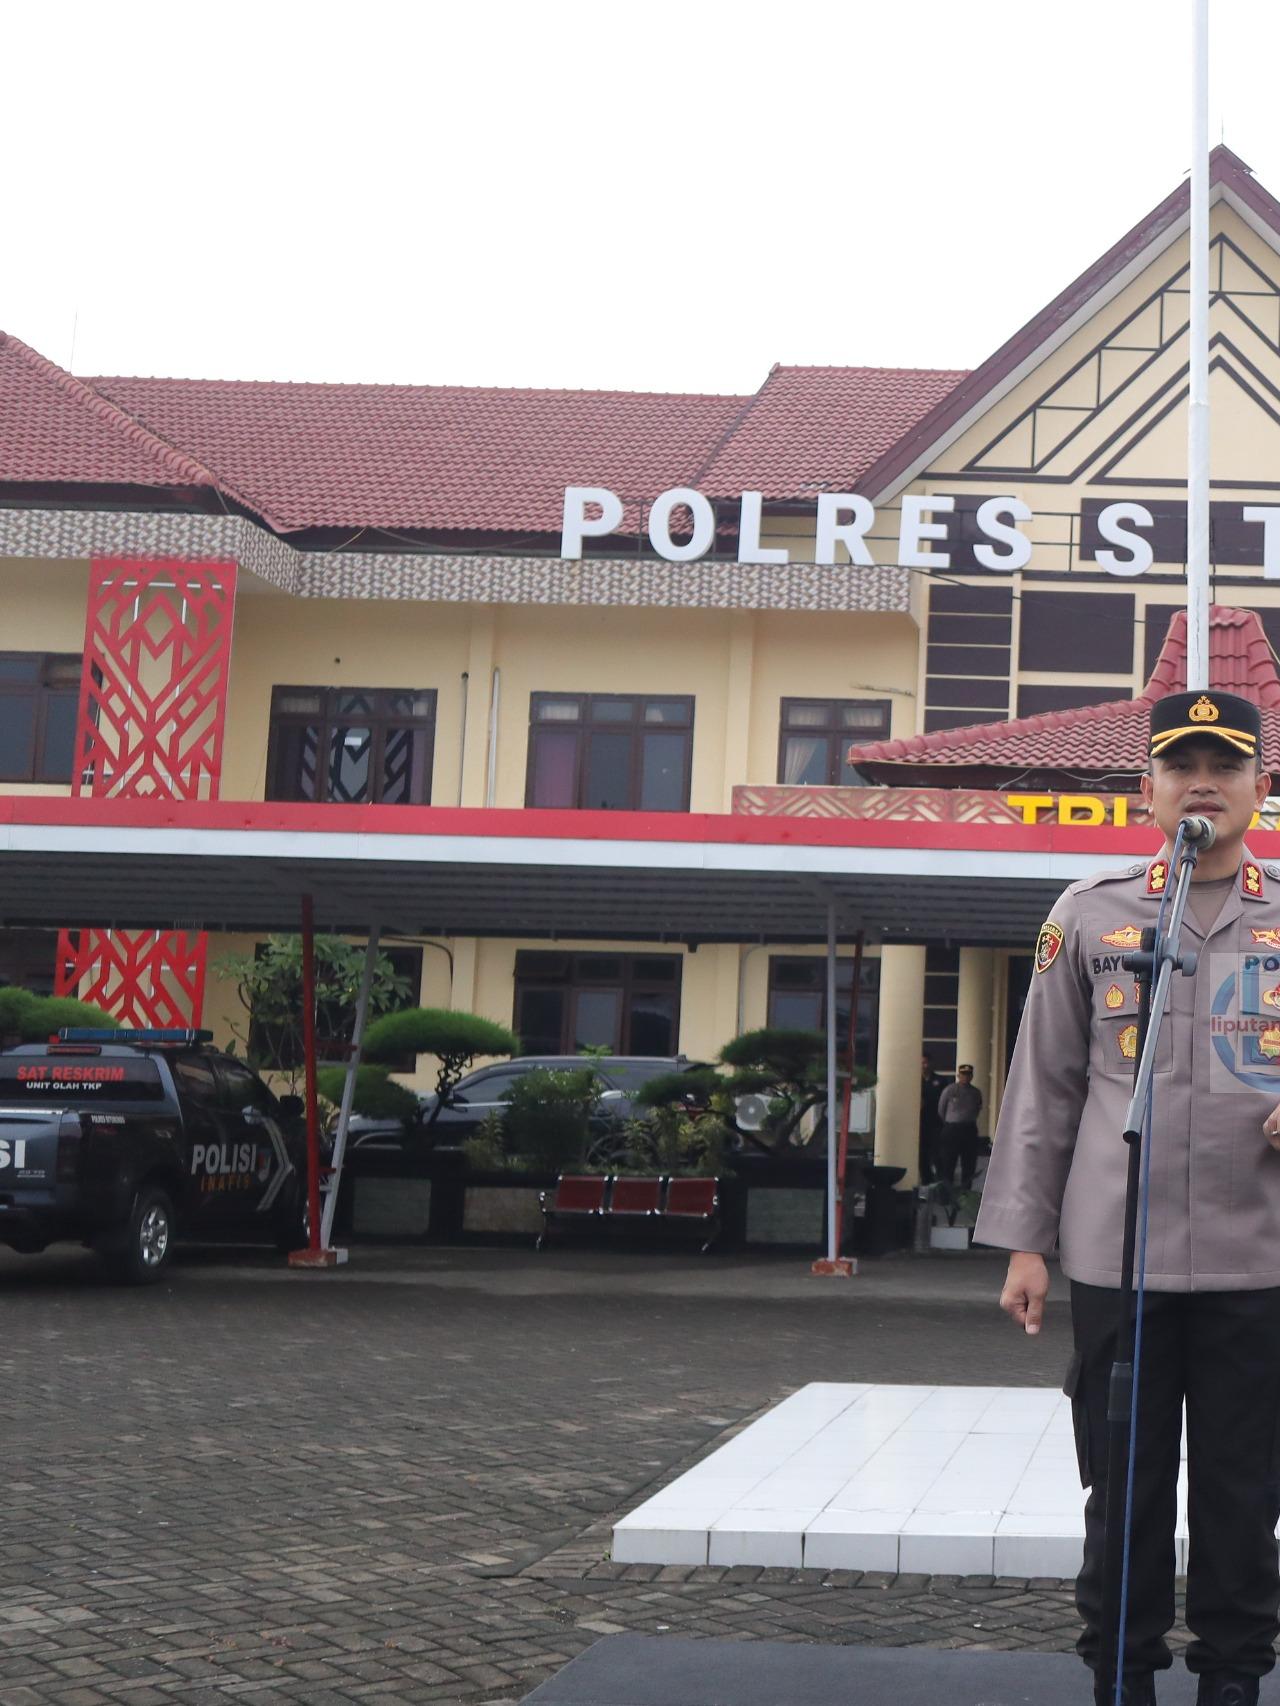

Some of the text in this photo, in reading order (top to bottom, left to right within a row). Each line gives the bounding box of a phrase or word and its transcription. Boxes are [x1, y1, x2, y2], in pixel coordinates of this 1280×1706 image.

[560, 487, 1033, 571] POLRES
[17, 1066, 125, 1081] SAT RESKRIM
[53, 1082, 79, 1090] OLAH
[82, 1082, 102, 1090] TKP
[191, 1144, 257, 1175] POLISI
